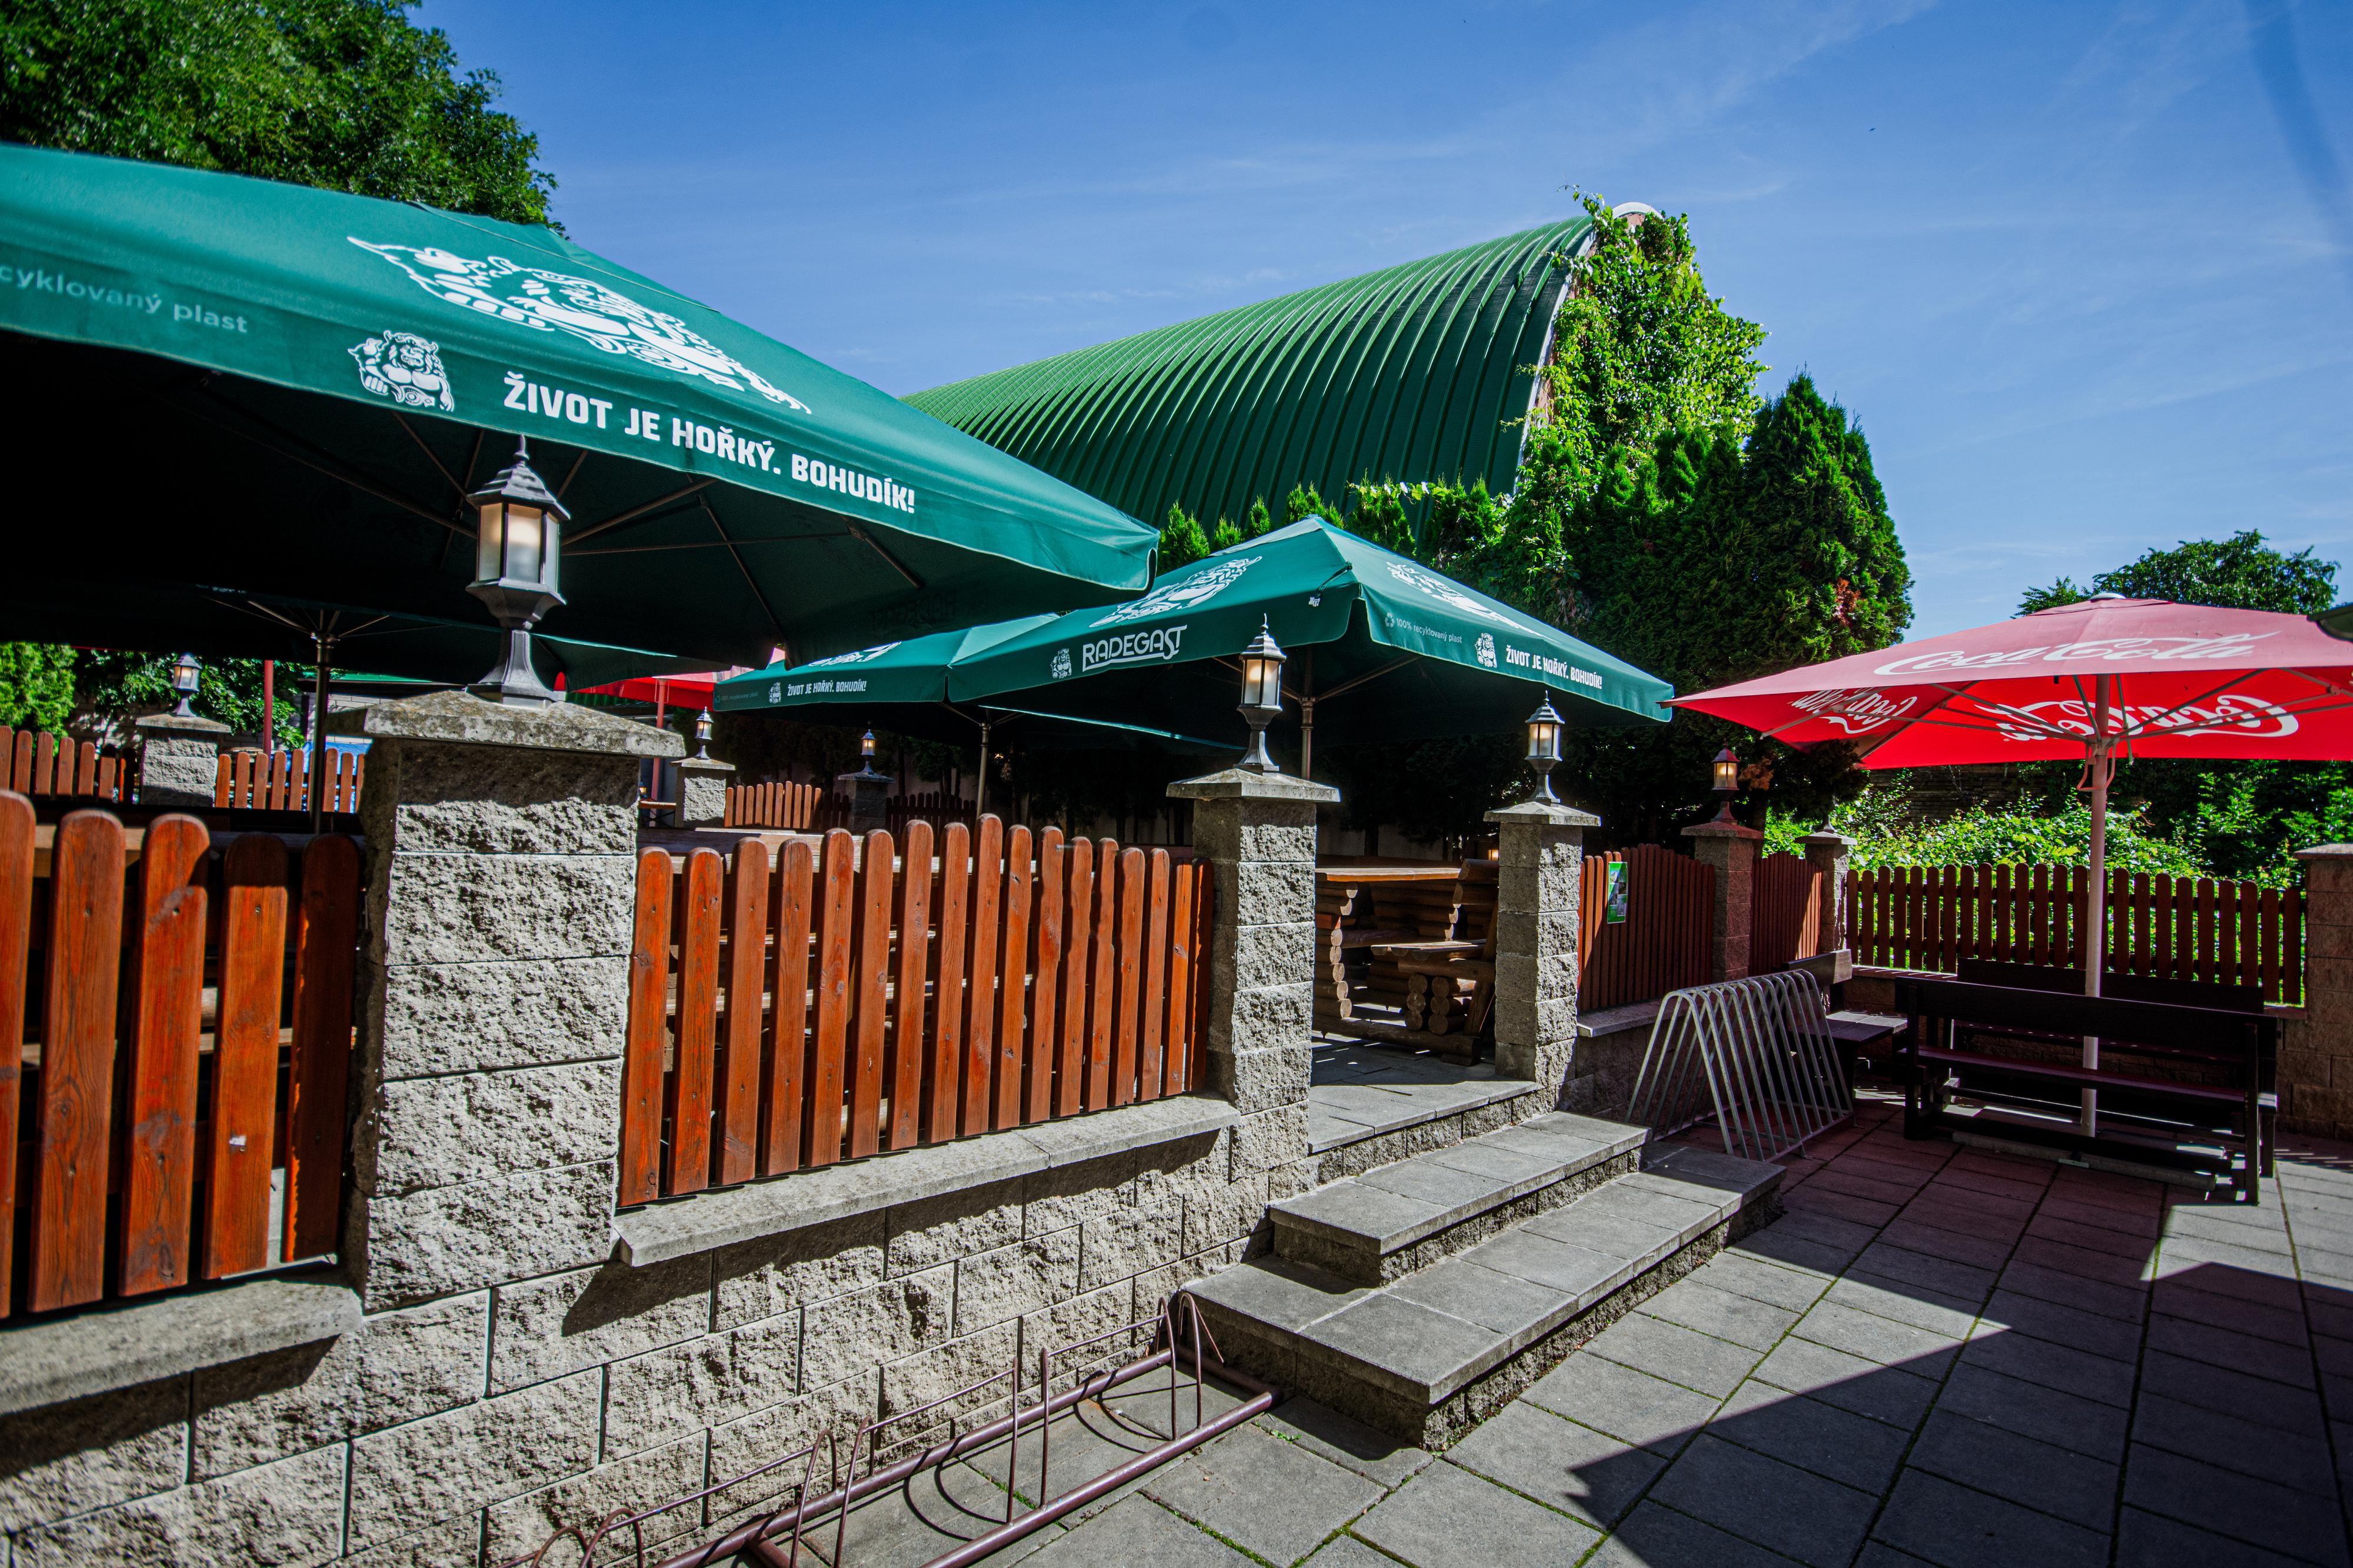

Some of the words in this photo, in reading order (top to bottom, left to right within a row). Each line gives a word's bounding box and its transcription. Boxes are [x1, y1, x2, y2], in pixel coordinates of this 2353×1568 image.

[174, 303, 248, 333] plast
[503, 371, 613, 429] ŽIVOT
[624, 407, 661, 442] JE
[672, 417, 782, 475] HOŘKÝ.
[791, 453, 916, 514] BOHUDÍK!
[1082, 624, 1188, 672] RADEGAST
[1396, 618, 1412, 630] 100%
[1413, 625, 1448, 642] recyklovaný
[1448, 633, 1463, 644] plast
[1505, 644, 1531, 668] ŽIVOT
[1532, 654, 1542, 670] JE
[1542, 657, 1569, 679] HOŘKÝ.
[1570, 666, 1602, 690] BOHUDÍK!
[787, 683, 805, 696] ŽIVOT
[805, 683, 812, 695] JE
[812, 679, 835, 693] HOŘKÝ.
[835, 678, 867, 693] BOHUDÍK!
